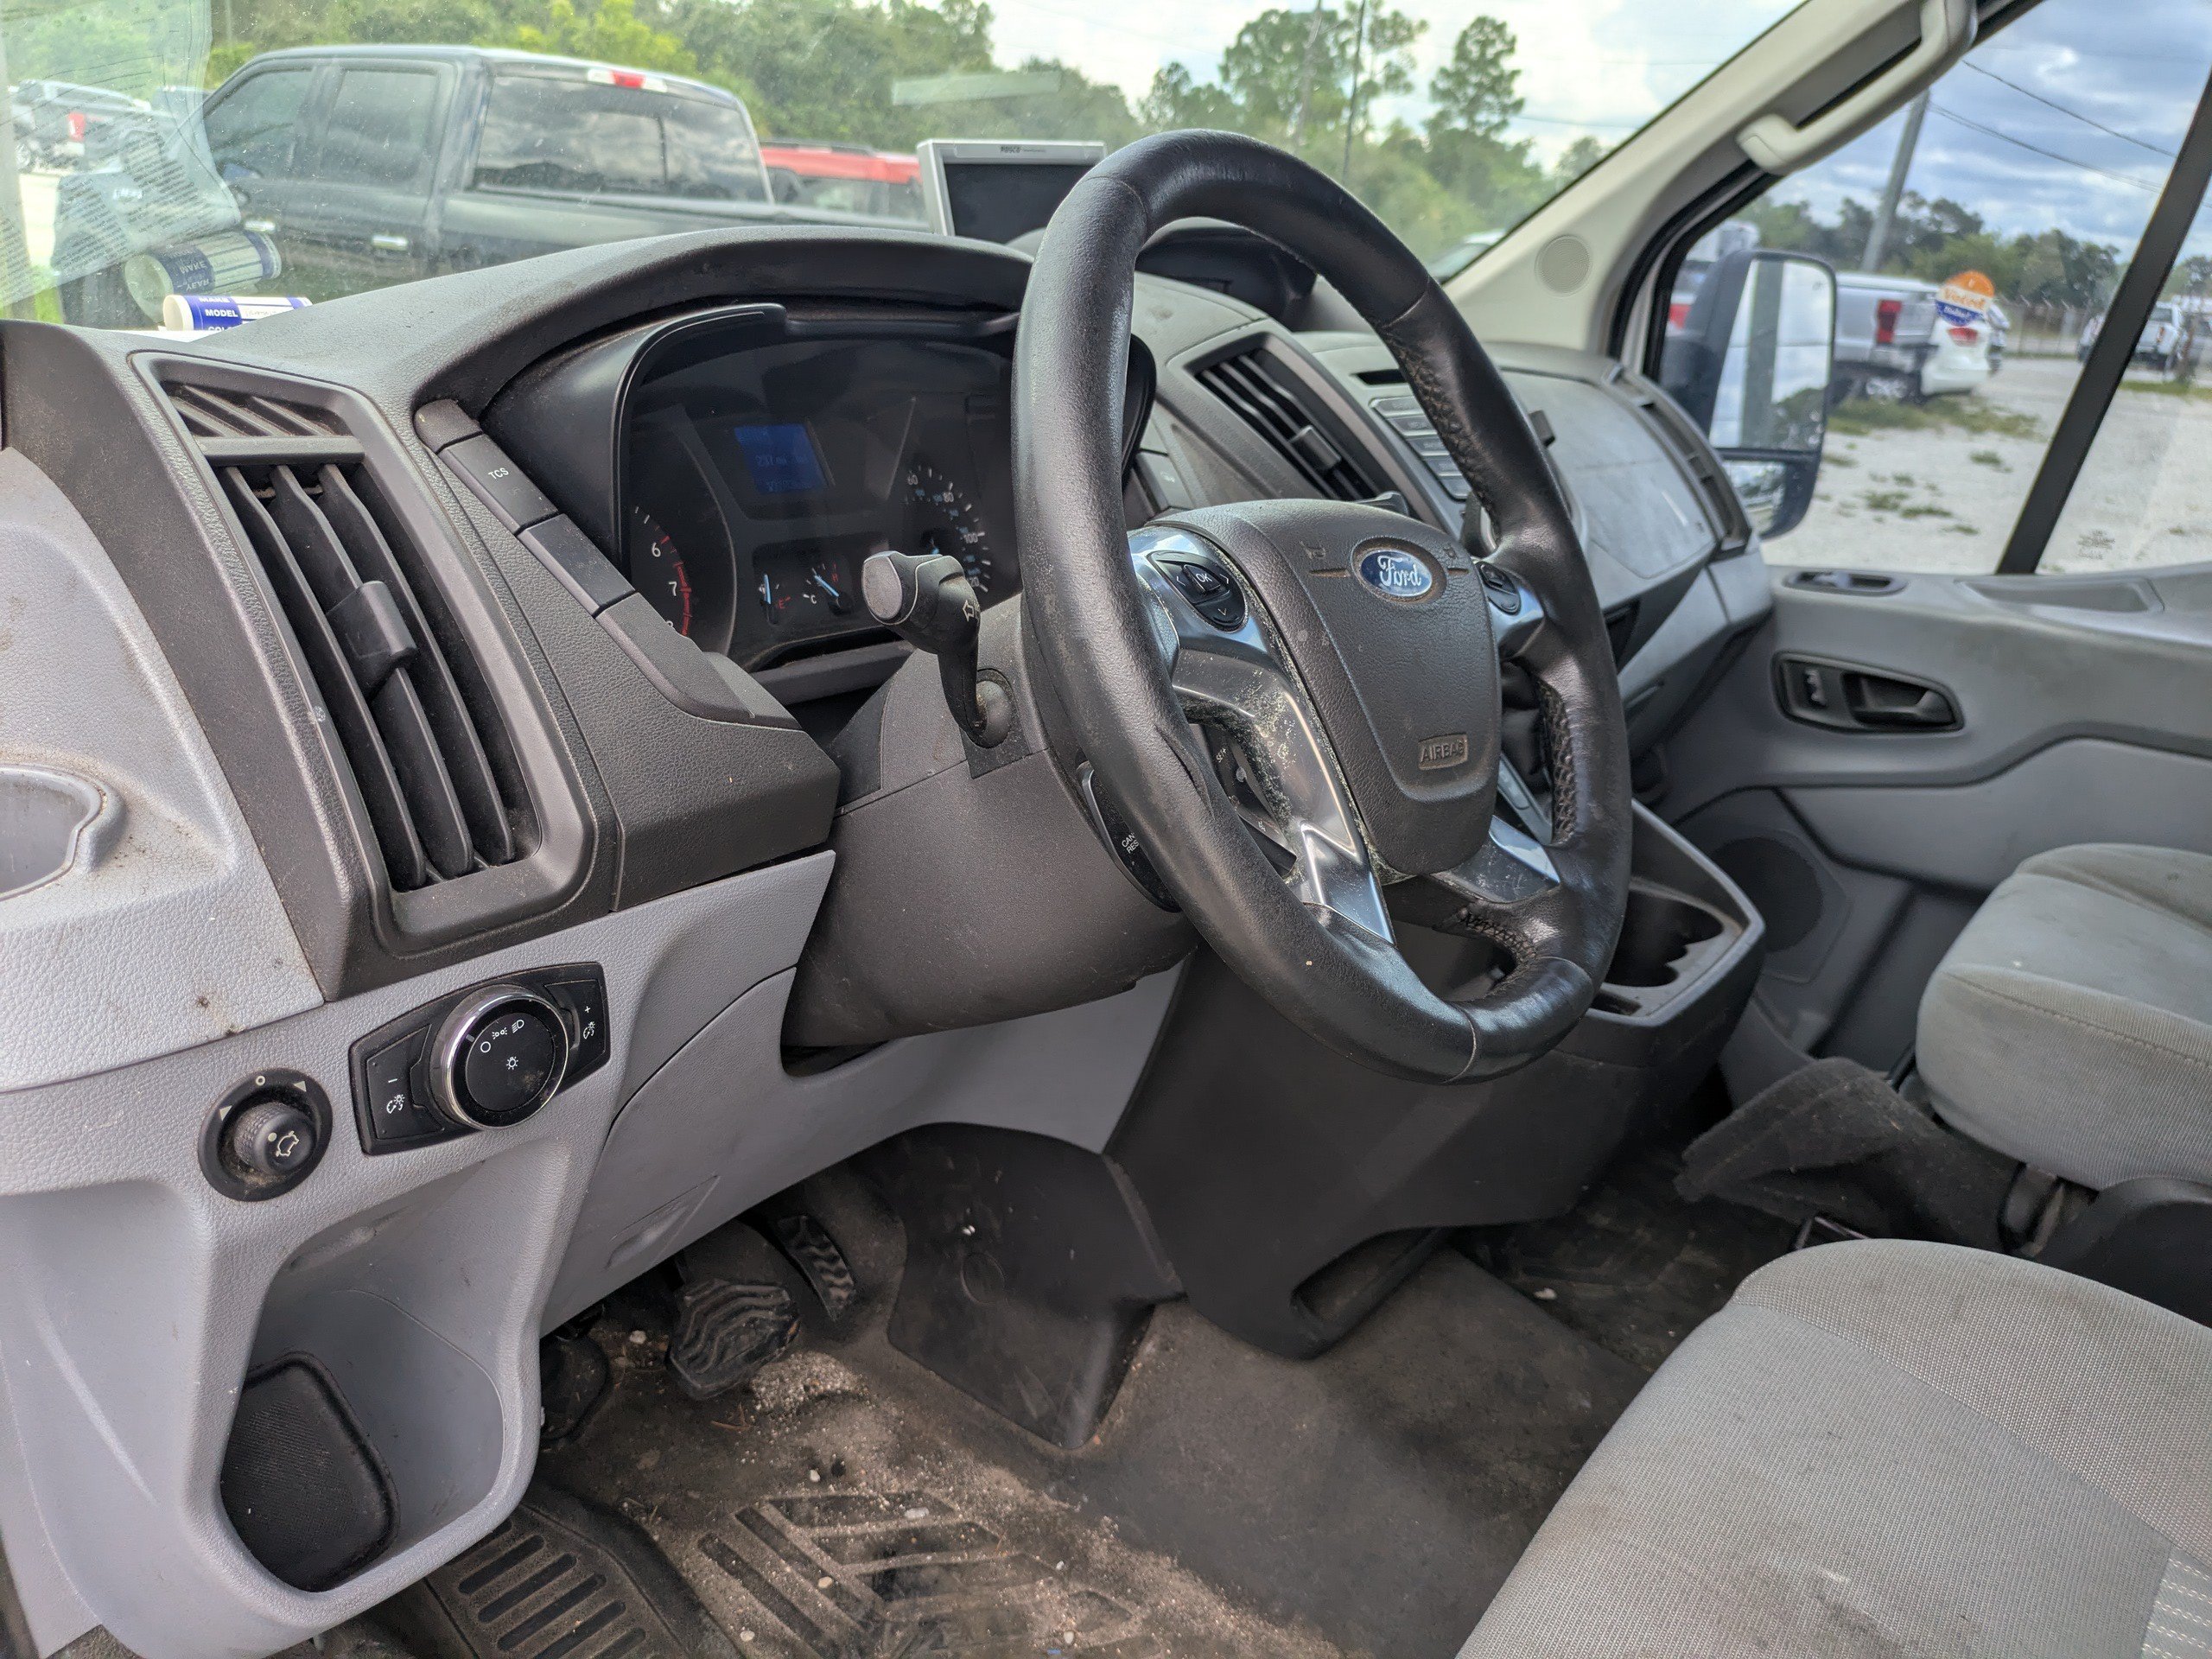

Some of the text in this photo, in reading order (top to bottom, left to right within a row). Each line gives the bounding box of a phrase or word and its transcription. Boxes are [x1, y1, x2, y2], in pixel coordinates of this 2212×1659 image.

[205, 308, 239, 318] MODEL
[487, 467, 509, 480] TCS
[963, 532, 978, 543] 100
[652, 542, 661, 557] 6
[1195, 572, 1213, 583] OK
[1376, 555, 1422, 587] Ford
[668, 581, 677, 597] 7
[810, 594, 817, 605] C
[1421, 741, 1465, 763] AIRBAG
[1121, 832, 1135, 848] CAN
[1126, 839, 1140, 854] RES
